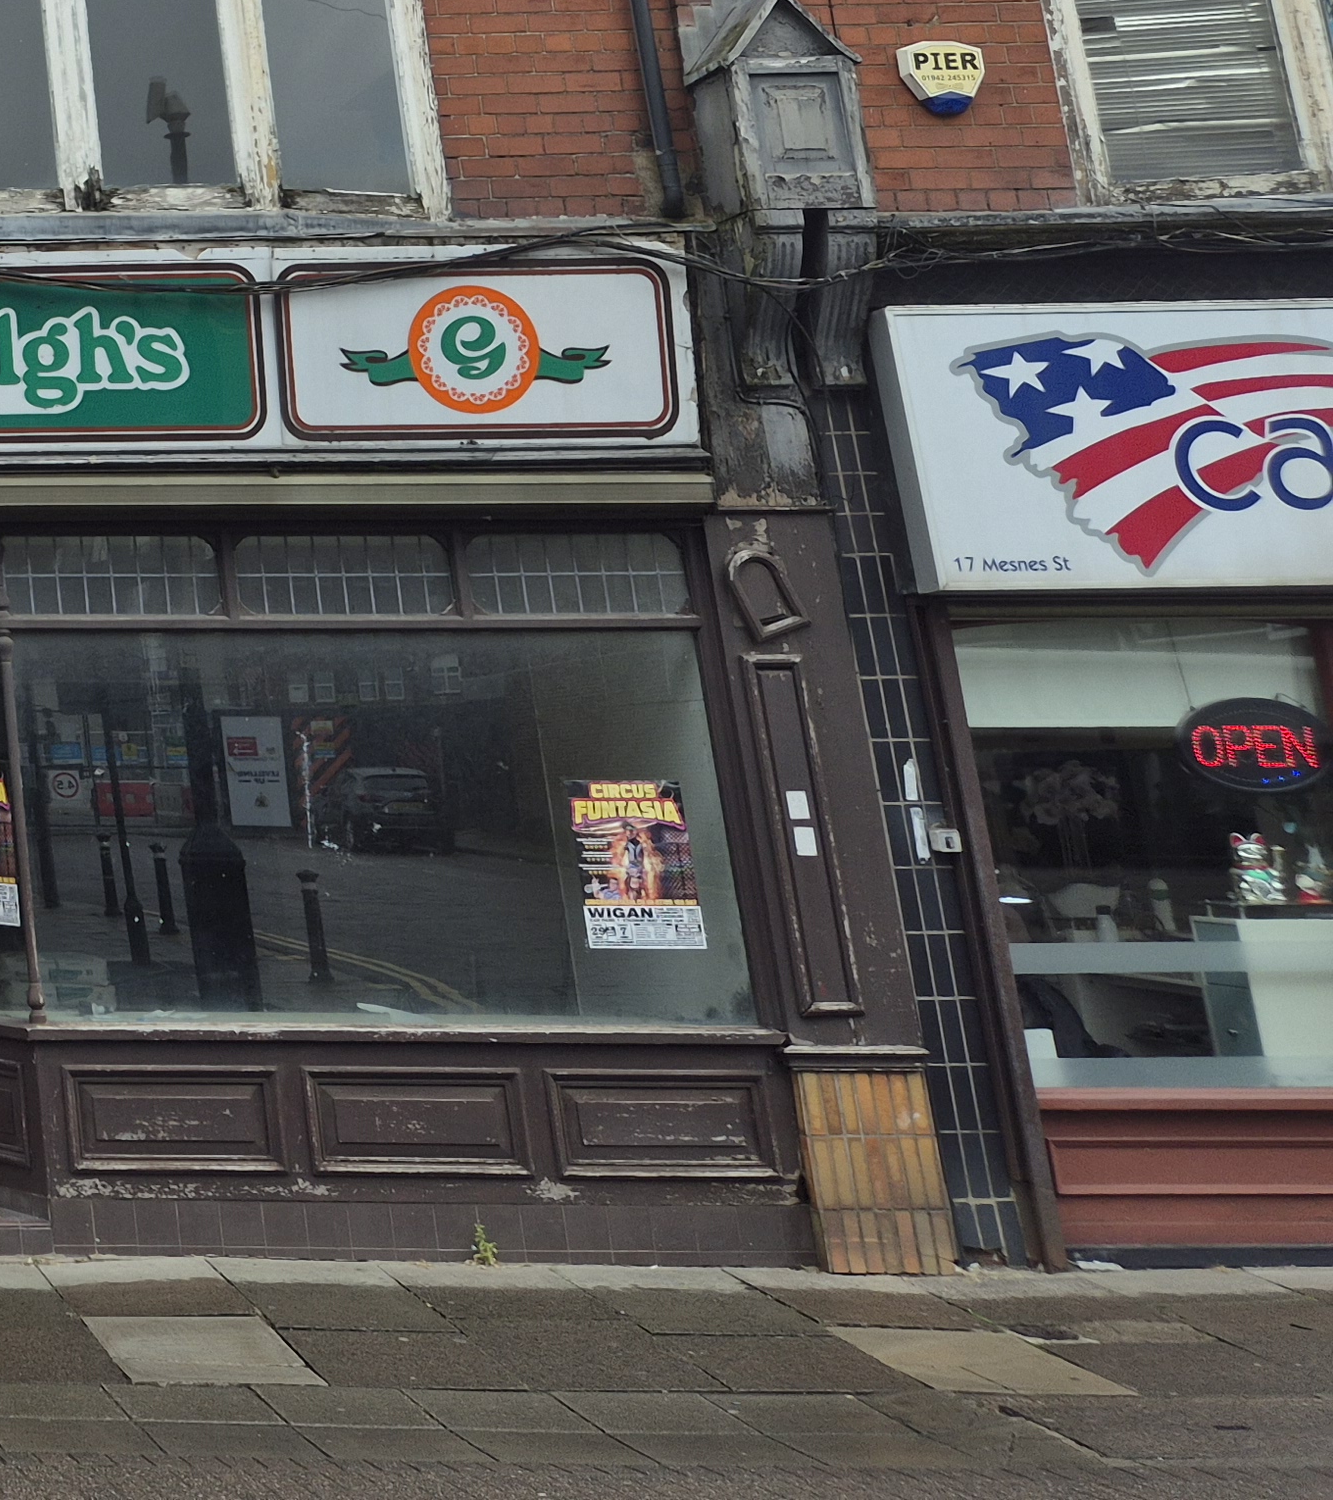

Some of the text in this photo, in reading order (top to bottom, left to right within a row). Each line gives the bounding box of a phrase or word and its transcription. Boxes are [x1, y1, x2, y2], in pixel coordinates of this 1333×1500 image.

[913, 52, 979, 70] PIER
[954, 556, 1072, 572] 17 Mesnes St
[1191, 725, 1322, 768] OPEN
[590, 784, 657, 798] CIRCUS
[574, 800, 682, 825] FUNTASIA
[587, 907, 654, 918] WIGAN
